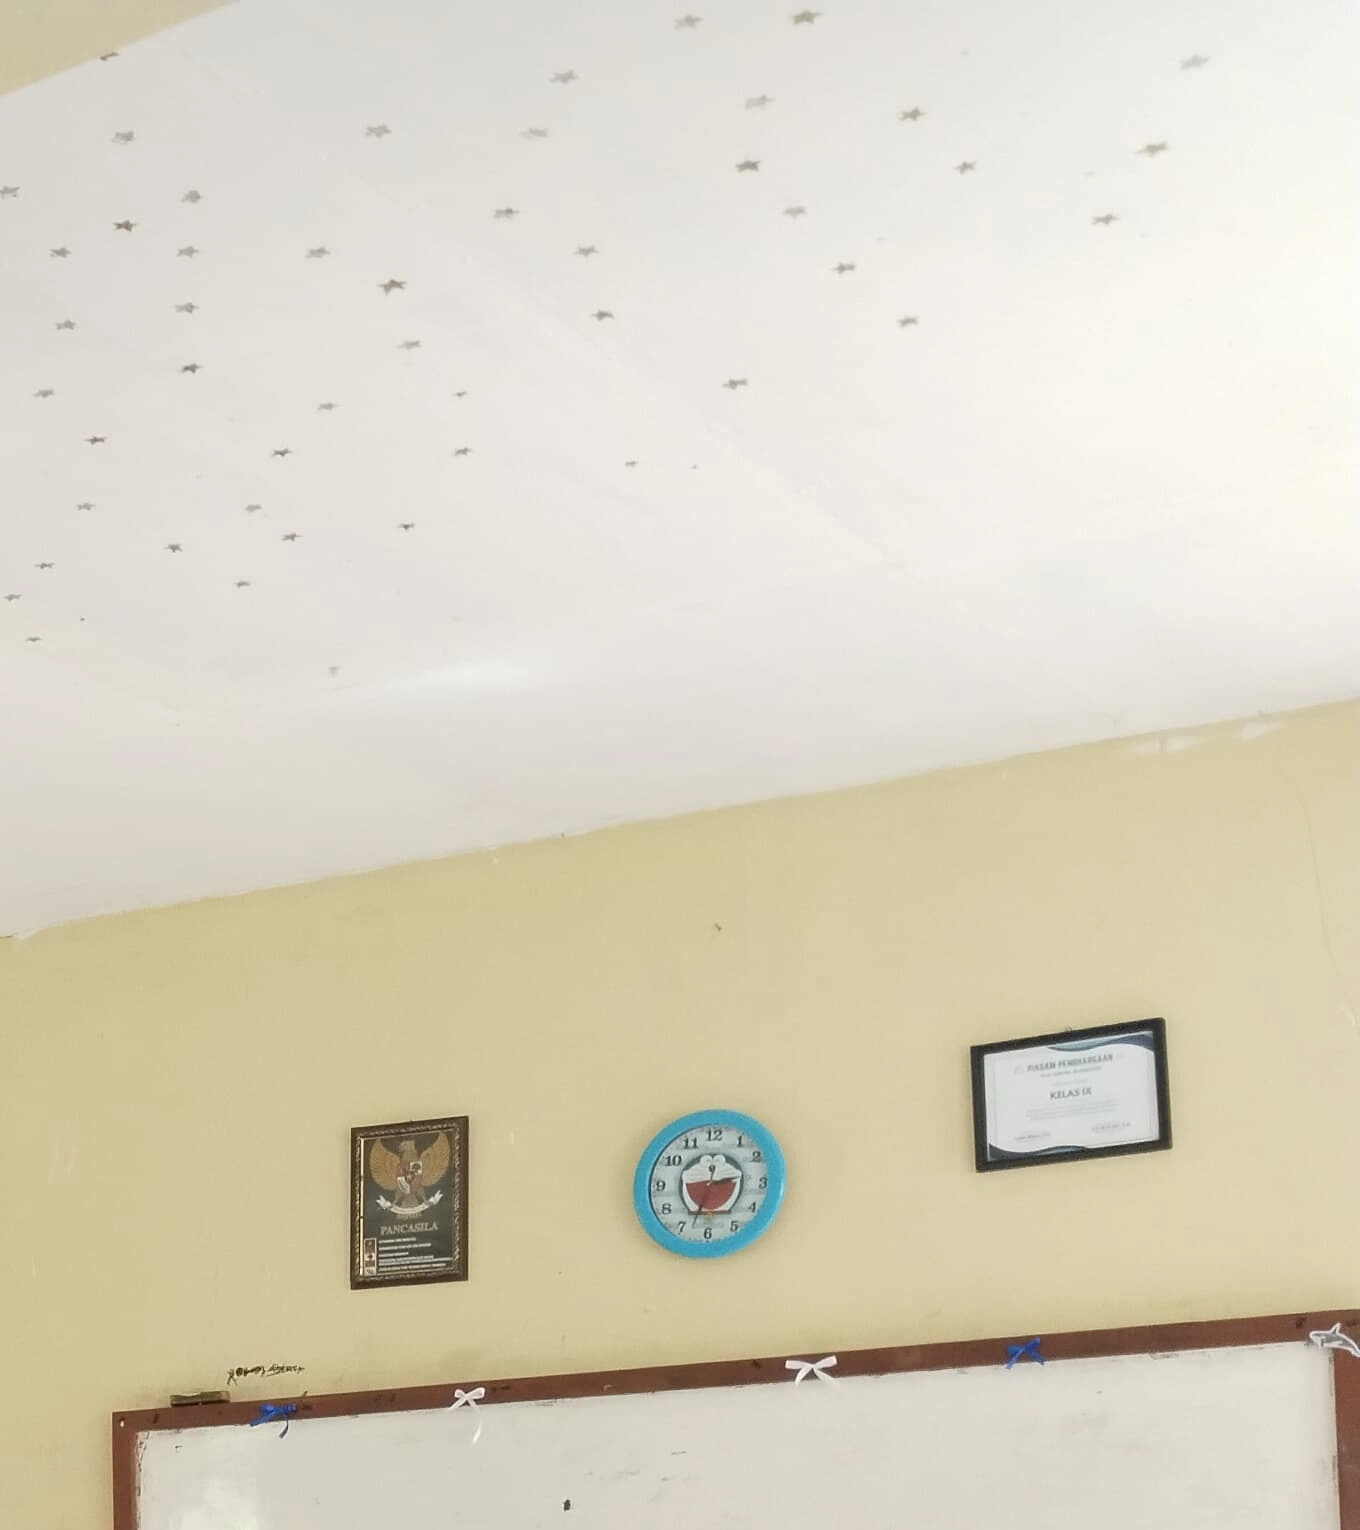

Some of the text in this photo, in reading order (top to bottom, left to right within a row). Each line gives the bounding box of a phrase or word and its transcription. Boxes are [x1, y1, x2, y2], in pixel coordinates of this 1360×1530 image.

[1049, 1088, 1080, 1101] KELAS
[705, 1129, 723, 1142] 12
[736, 1135, 743, 1147] 1
[682, 1137, 699, 1149] 11
[665, 1154, 682, 1167] 10
[751, 1151, 761, 1163] 2
[655, 1180, 666, 1191] 9
[758, 1177, 768, 1189] 3
[661, 1203, 672, 1215] 8
[748, 1201, 757, 1213] 4
[380, 1221, 439, 1236] PANCASILA
[678, 1221, 687, 1233] 7
[730, 1221, 739, 1232] 5
[703, 1227, 712, 1240] 6
